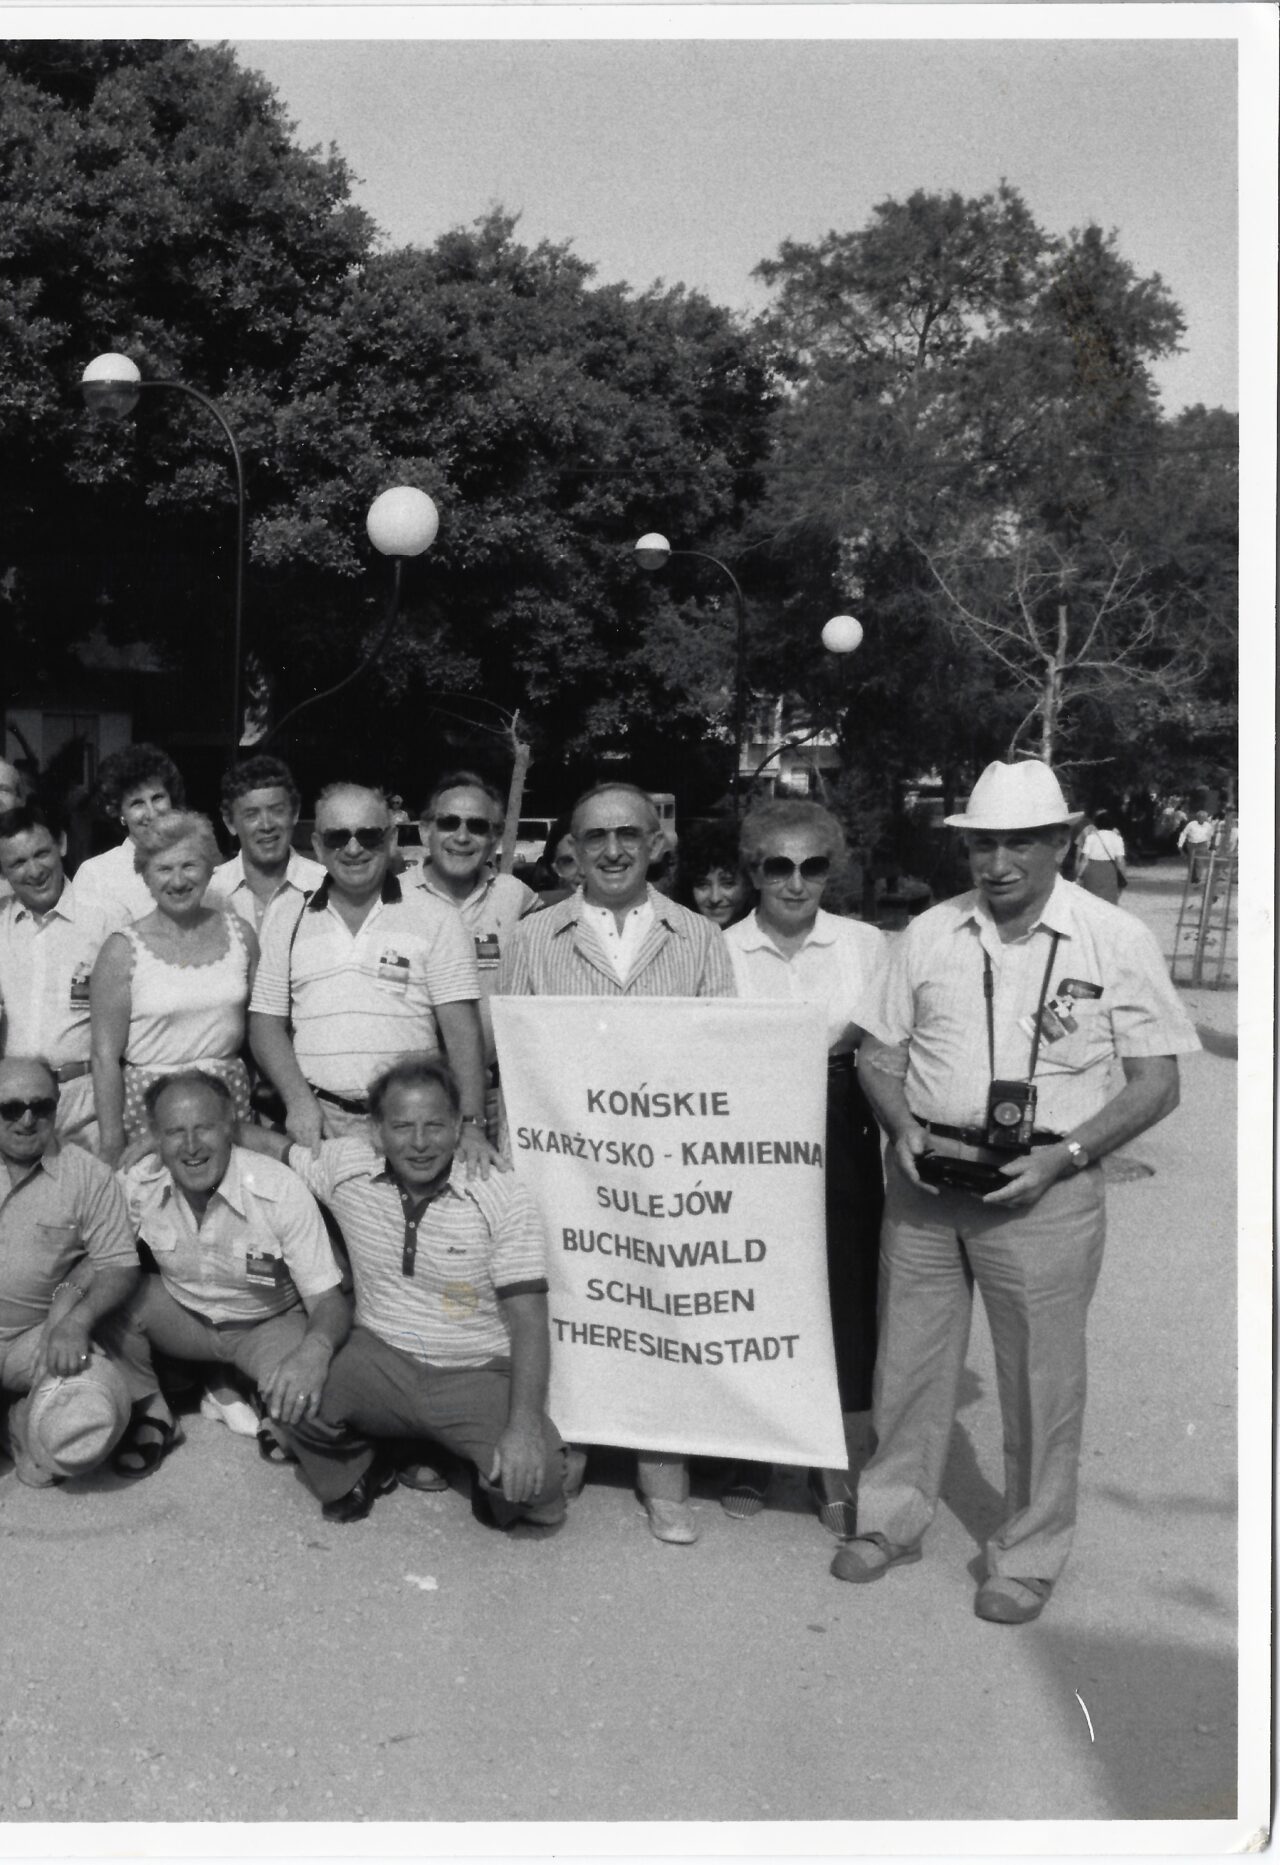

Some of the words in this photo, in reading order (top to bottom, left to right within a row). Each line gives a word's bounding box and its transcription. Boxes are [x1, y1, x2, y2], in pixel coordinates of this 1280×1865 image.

[587, 1082, 731, 1118] KOŃSKIE
[517, 1126, 655, 1169] SKARŻYSKO
[681, 1140, 823, 1169] KAMIENNA
[596, 1180, 733, 1219] SULEJÓW
[562, 1227, 767, 1268] BUCHENWALD
[586, 1278, 755, 1317] SCHLIEBEN
[552, 1318, 800, 1366] THERESIENSTADT
